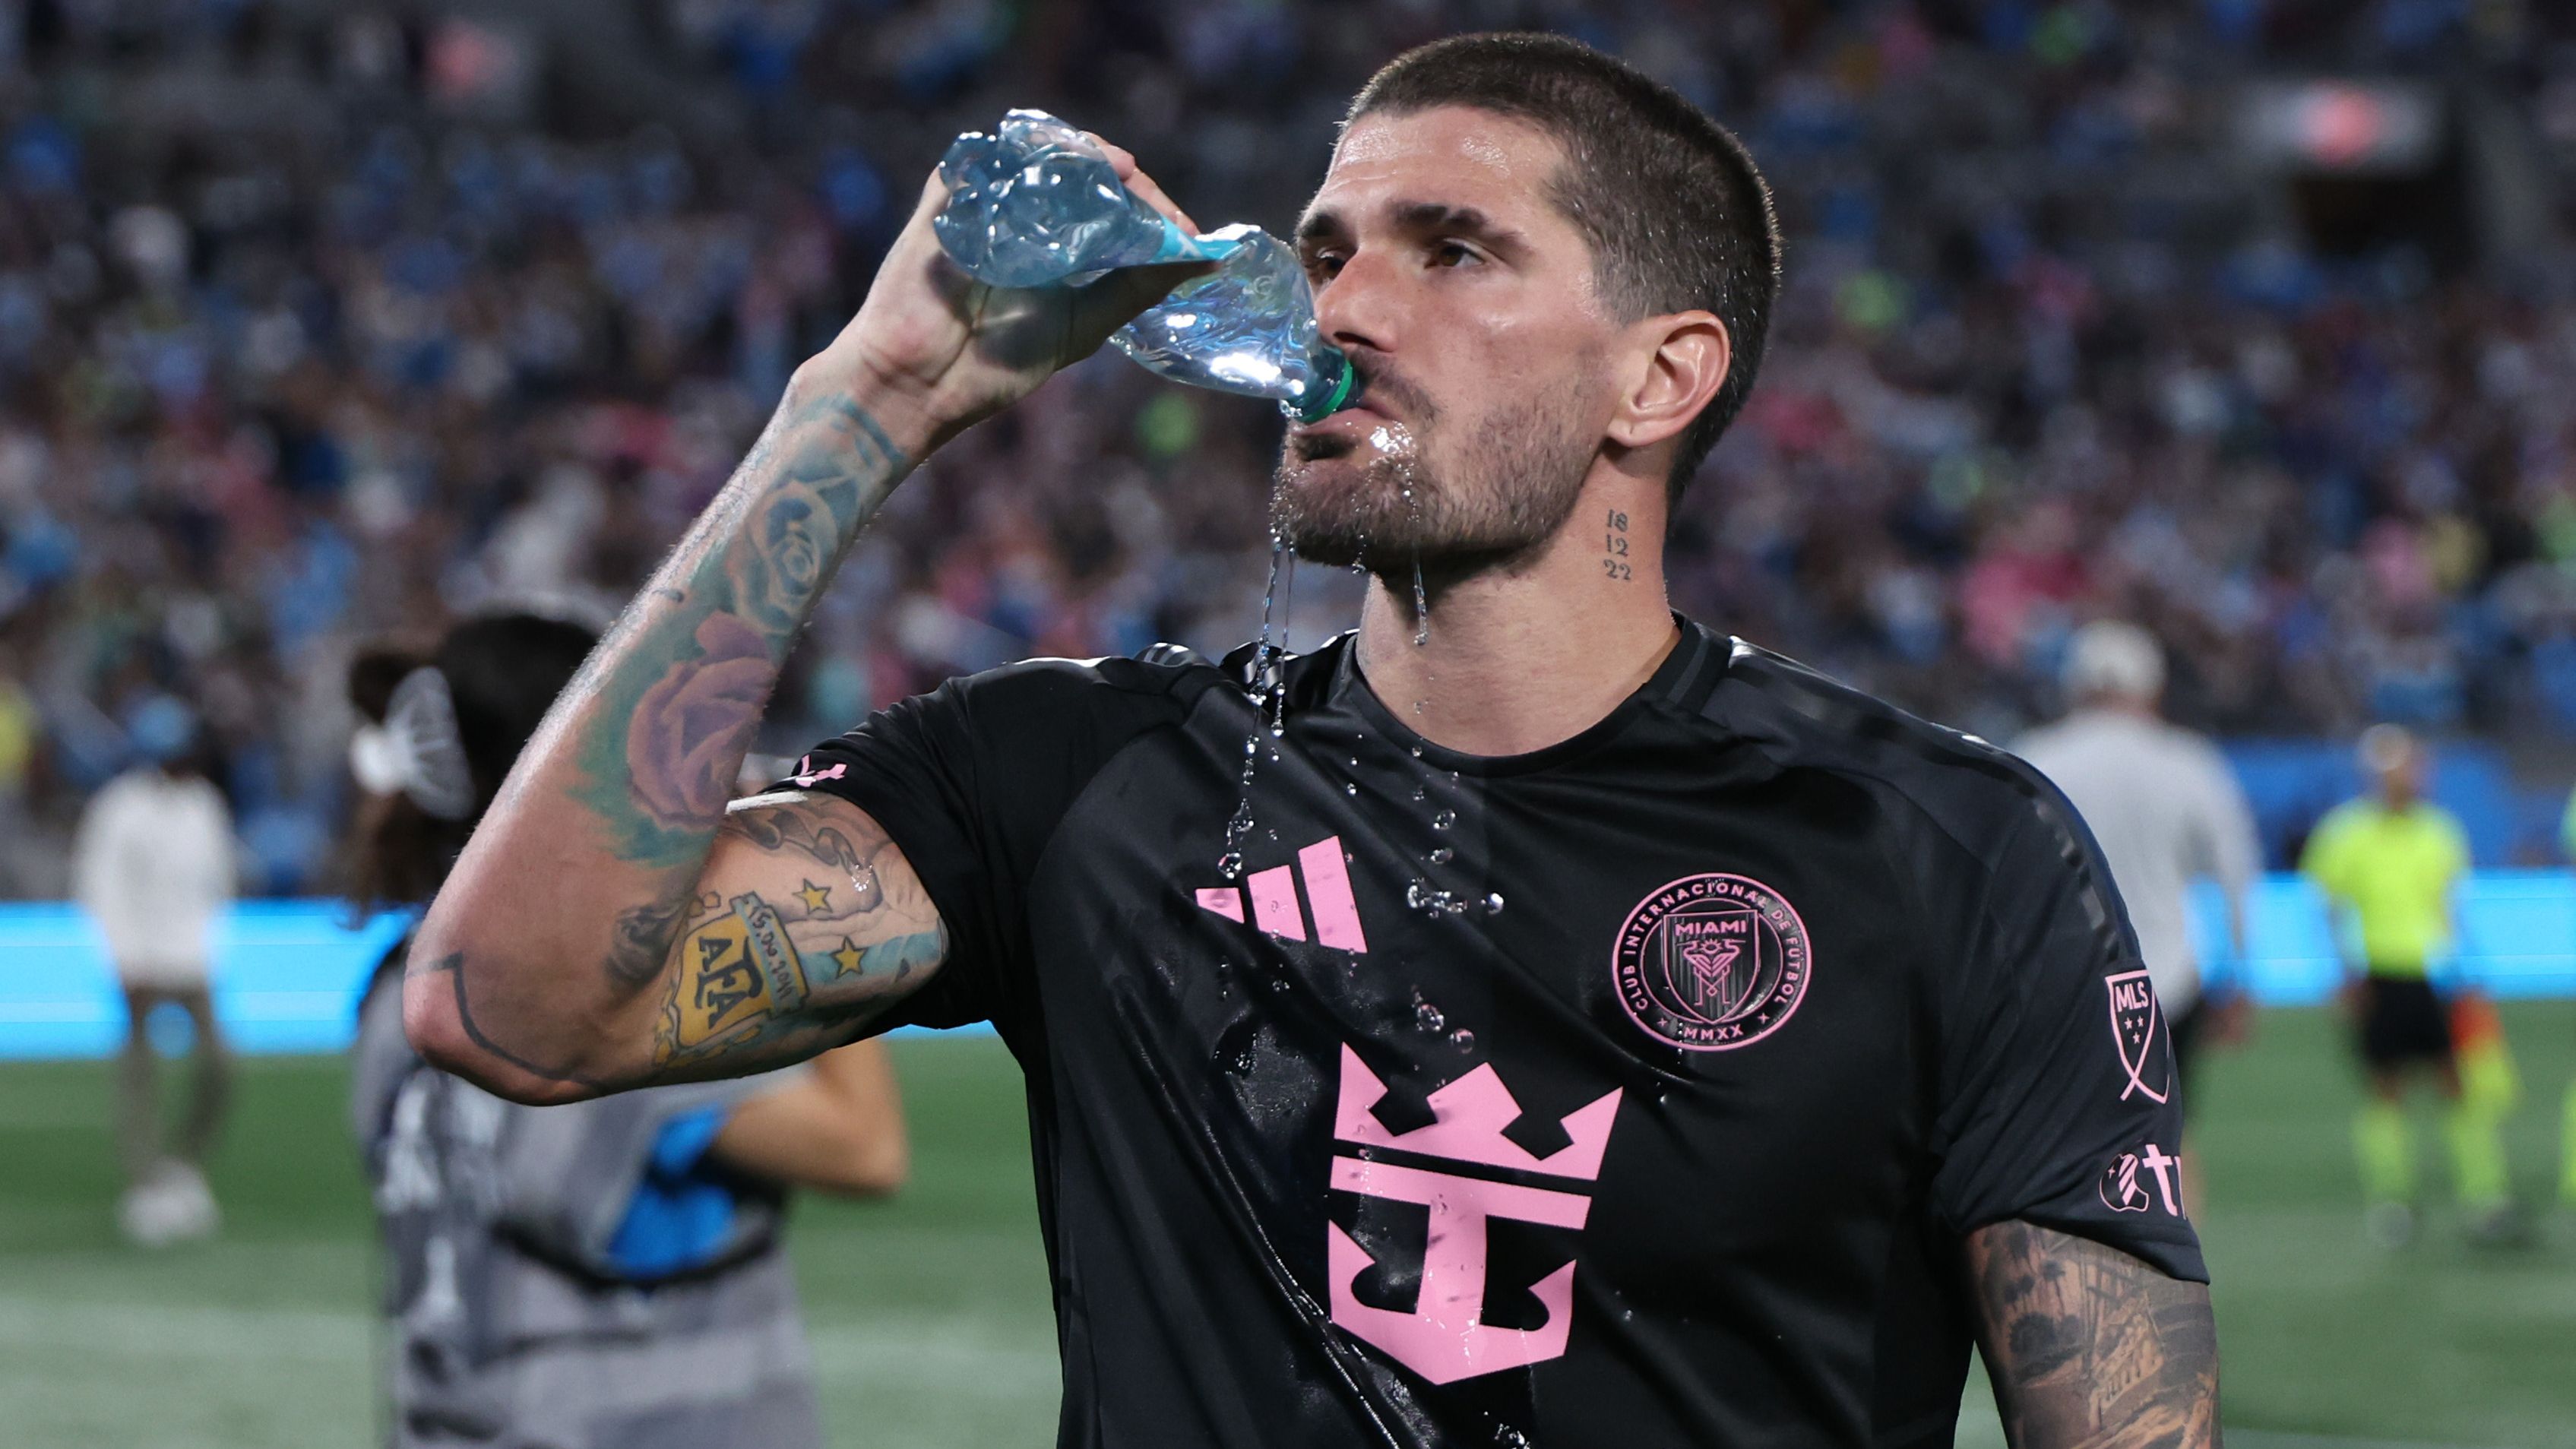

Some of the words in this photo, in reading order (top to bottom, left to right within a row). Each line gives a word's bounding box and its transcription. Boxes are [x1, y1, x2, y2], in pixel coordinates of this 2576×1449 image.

[1606, 508, 1628, 533] 18
[1606, 534, 1629, 558] 12
[1603, 558, 1631, 581] 22
[1623, 881, 1766, 957] INTERNACIONAL
[1674, 919, 1748, 937] MIAMI
[1771, 909, 1791, 931] DE
[695, 935, 764, 1030] AFA
[1623, 964, 1648, 1011] CLUB
[2115, 979, 2150, 1014] MLS
[1682, 1023, 1745, 1040] MMXX
